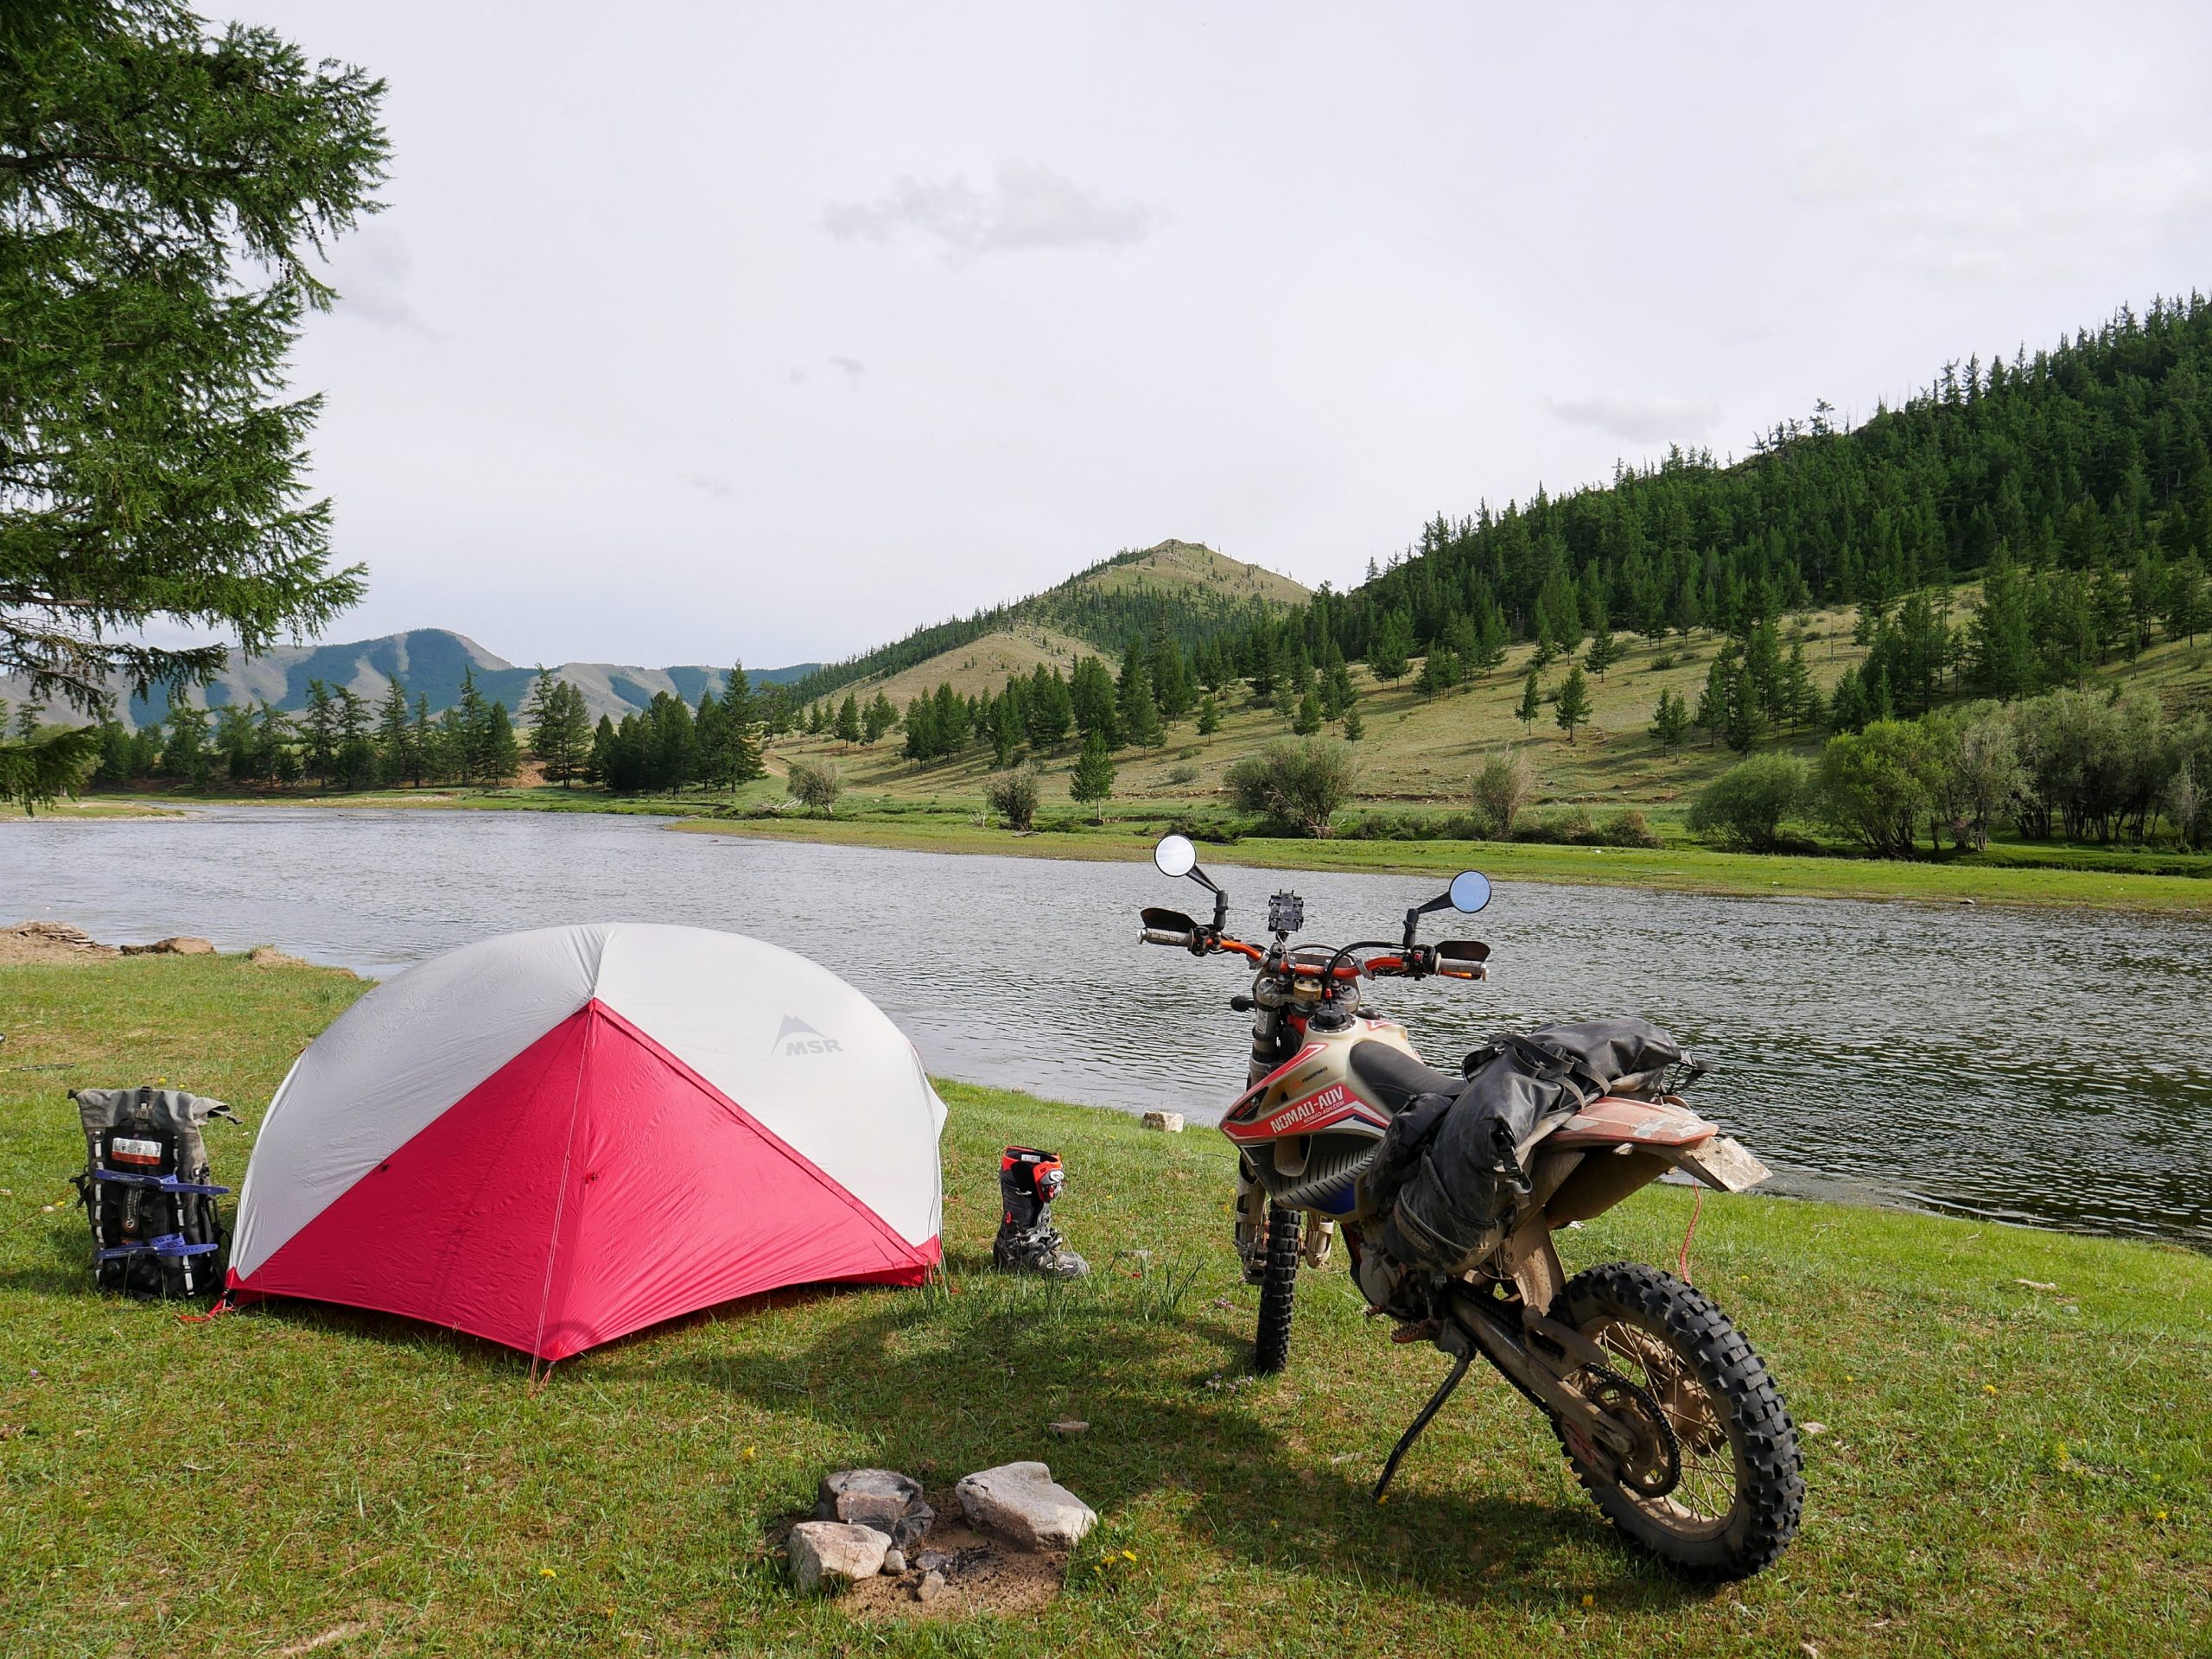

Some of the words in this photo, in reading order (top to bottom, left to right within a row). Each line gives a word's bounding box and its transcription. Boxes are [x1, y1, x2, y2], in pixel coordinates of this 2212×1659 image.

[785, 1039, 844, 1056] MSR
[1269, 1086, 1344, 1134] NOMAD-ADV
[1303, 1100, 1345, 1124] NOMAD-ADV.COM
